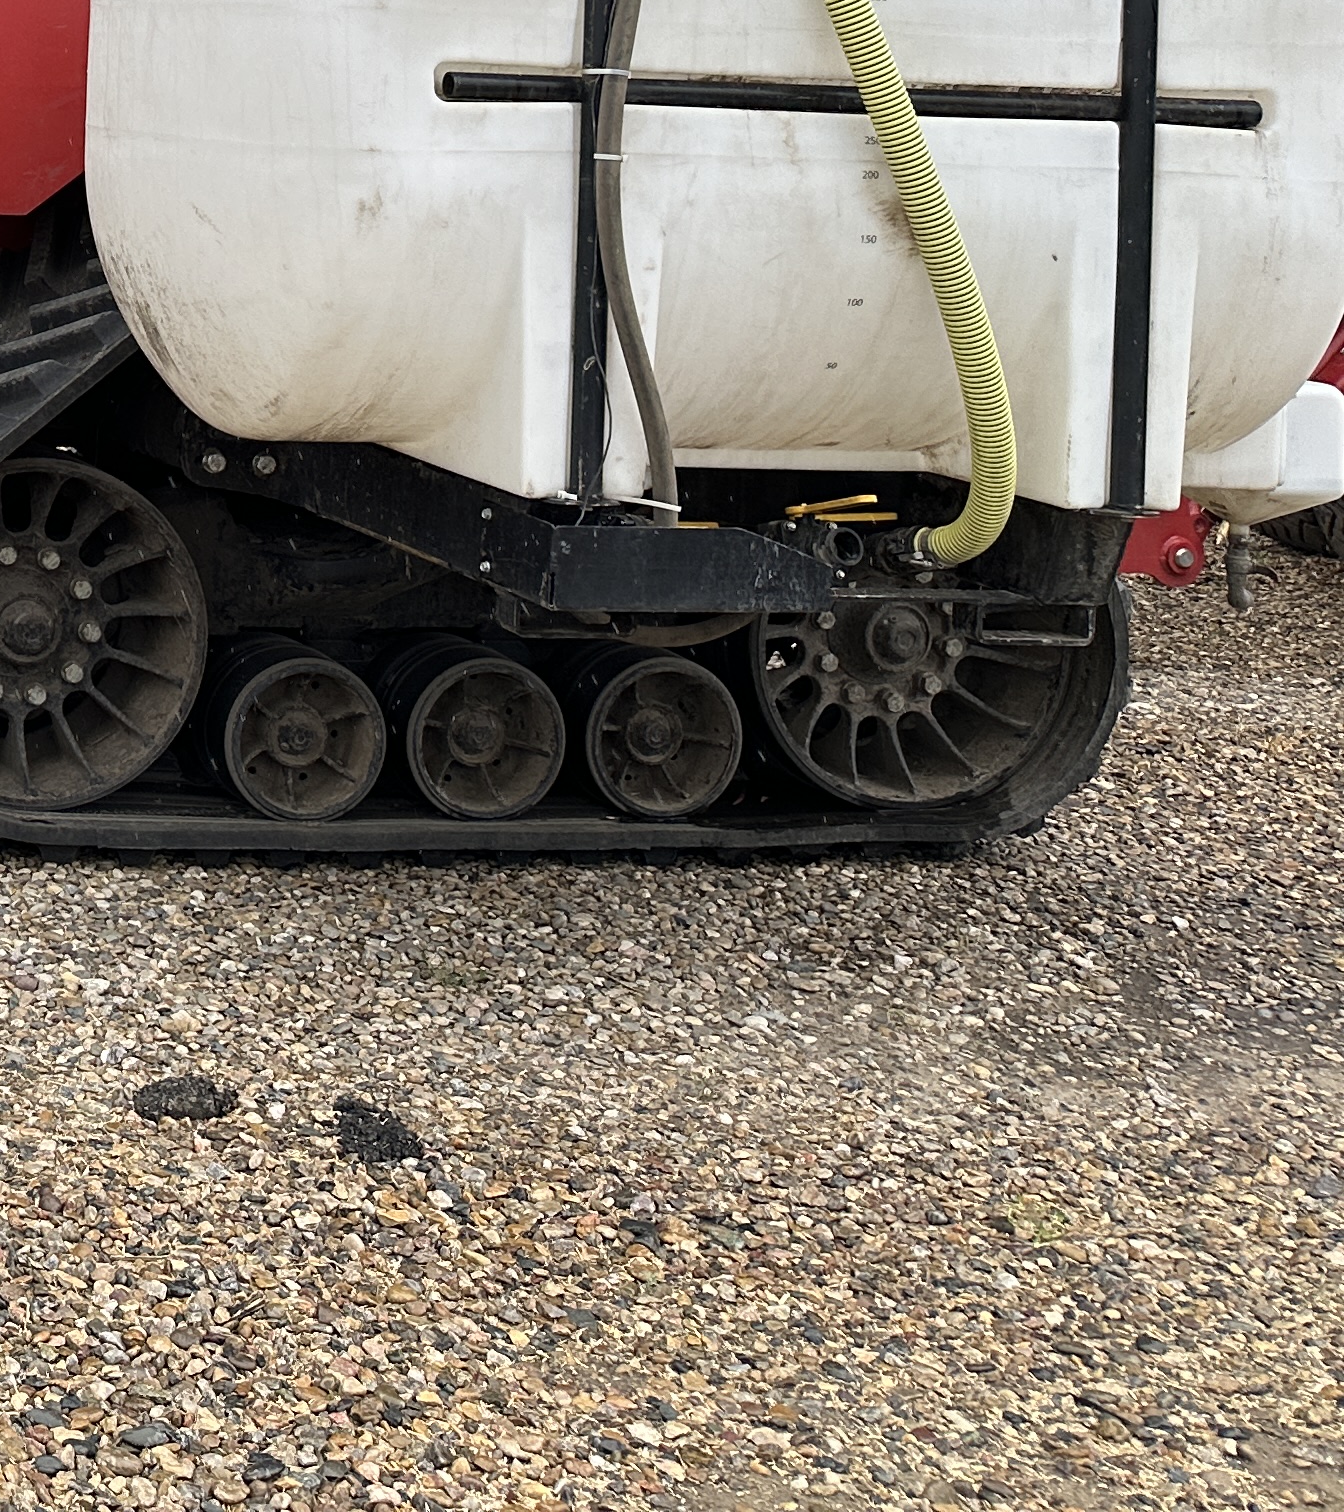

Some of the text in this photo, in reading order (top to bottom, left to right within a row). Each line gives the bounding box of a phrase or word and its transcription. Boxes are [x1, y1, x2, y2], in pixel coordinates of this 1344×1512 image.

[862, 171, 879, 179] 200
[860, 235, 877, 244] 150
[847, 298, 864, 307] 100
